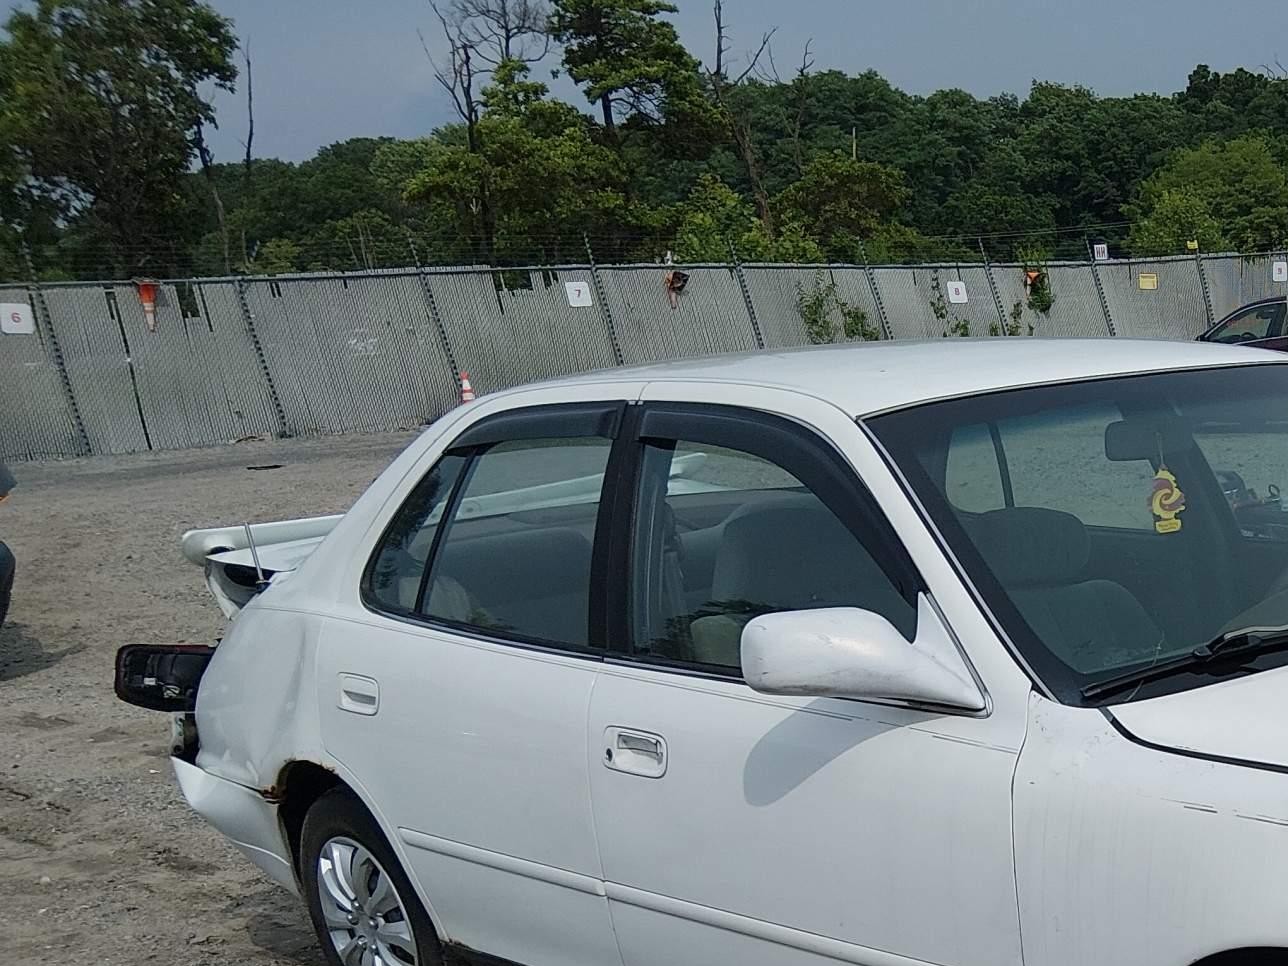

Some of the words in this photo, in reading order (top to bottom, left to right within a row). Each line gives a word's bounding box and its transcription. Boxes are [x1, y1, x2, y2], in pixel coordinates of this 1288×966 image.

[574, 289, 582, 298] 7
[954, 287, 960, 296] 8
[11, 312, 22, 323] 6
